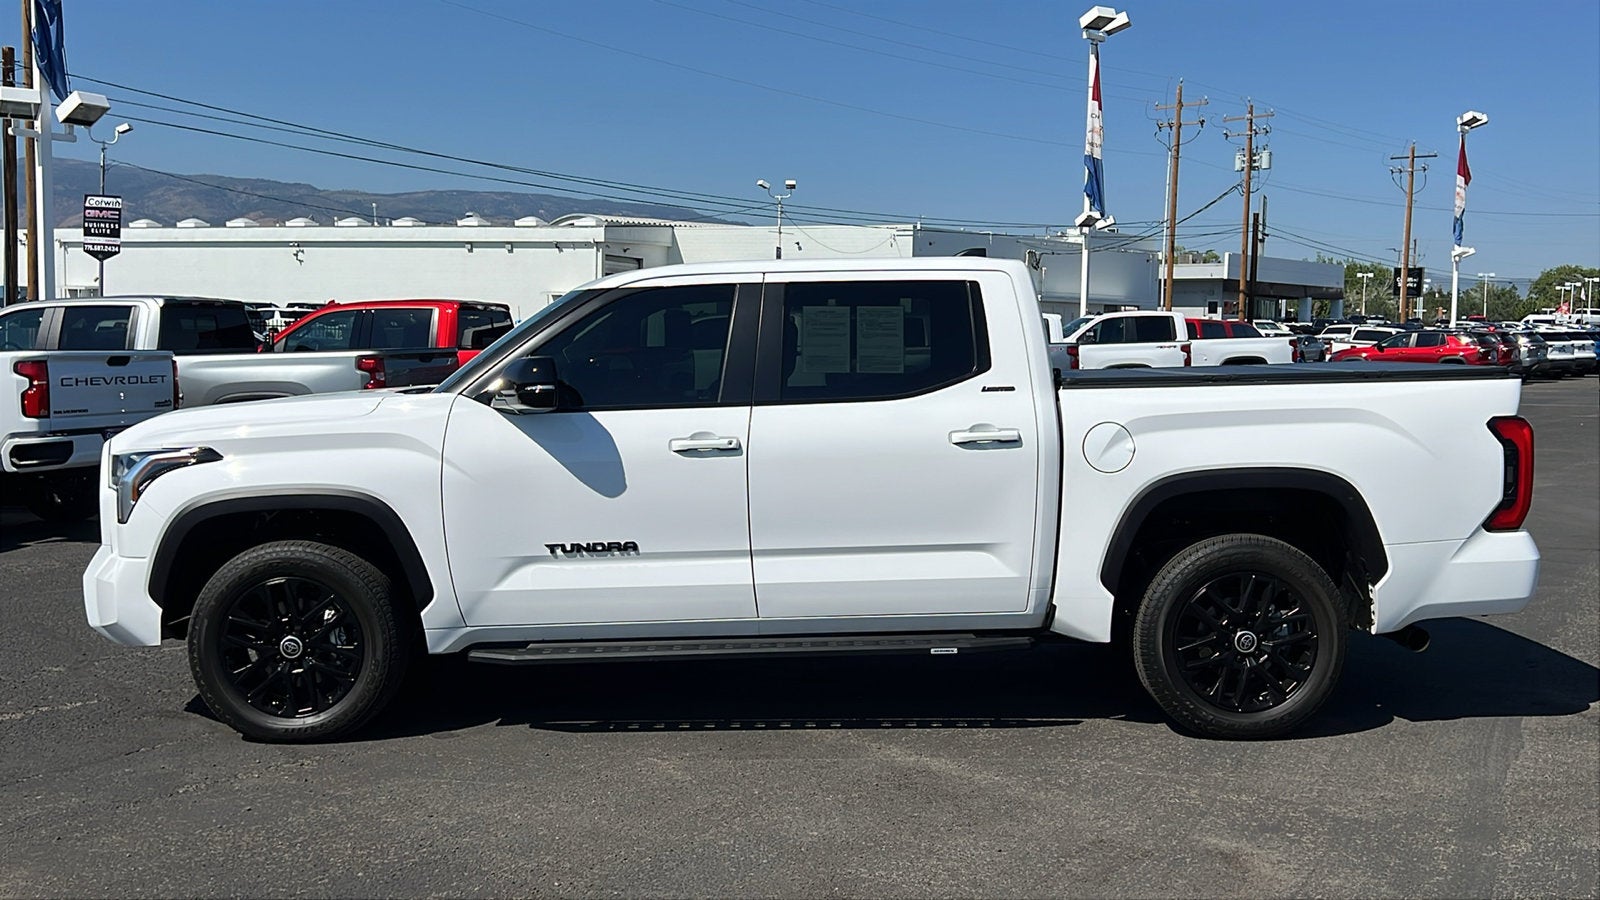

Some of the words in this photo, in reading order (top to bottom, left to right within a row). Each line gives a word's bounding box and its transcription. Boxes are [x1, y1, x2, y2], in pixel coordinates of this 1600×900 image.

[88, 198, 121, 207] Corwin
[85, 209, 119, 218] GMC
[60, 375, 167, 387] CHEVROLET
[544, 541, 639, 554] TUNDRA
